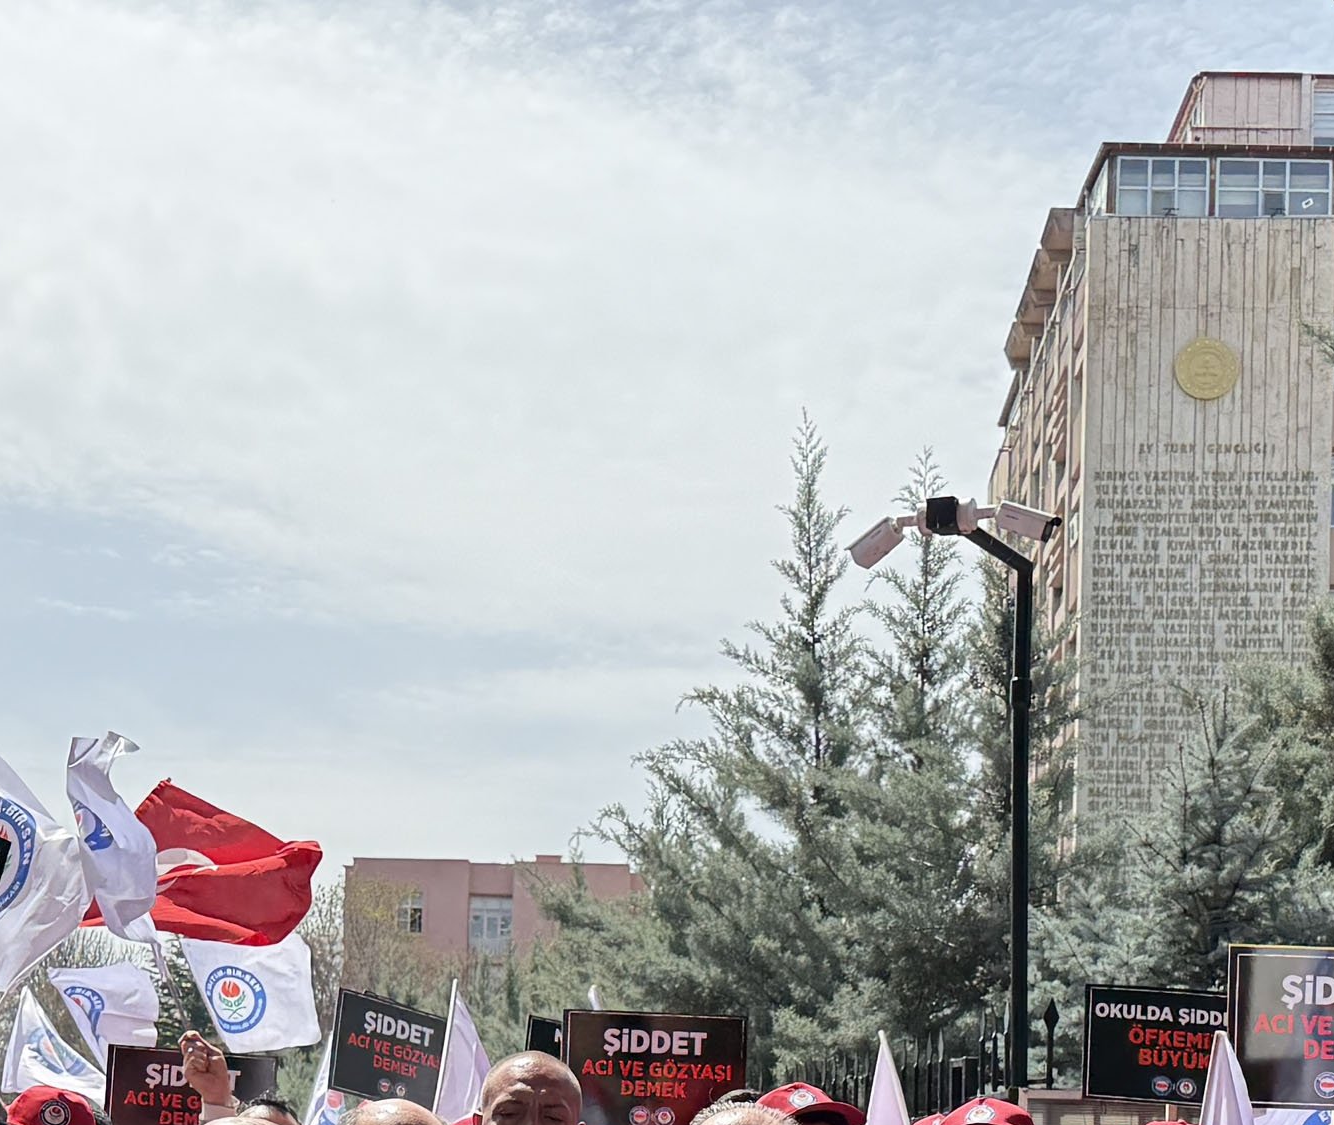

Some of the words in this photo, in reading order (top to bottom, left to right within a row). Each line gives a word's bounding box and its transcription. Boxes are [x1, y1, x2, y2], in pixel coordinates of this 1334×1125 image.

[1095, 1002, 1174, 1022] OKULDA
[364, 1010, 434, 1048] ŞİDDET
[1254, 1013, 1294, 1035] ACI
[1301, 1014, 1334, 1036] VE
[374, 1039, 392, 1055] VE
[603, 1028, 708, 1057] ŞİDDET
[1129, 1024, 1214, 1049] ÖFKEMİ
[373, 1055, 417, 1078] DEMEK
[582, 1059, 613, 1076] ACI
[619, 1060, 644, 1077] VE
[649, 1059, 732, 1082] GÖZYAŞI
[124, 1089, 155, 1105] ACI
[160, 1093, 183, 1109] VE
[620, 1080, 687, 1099] DEMEK
